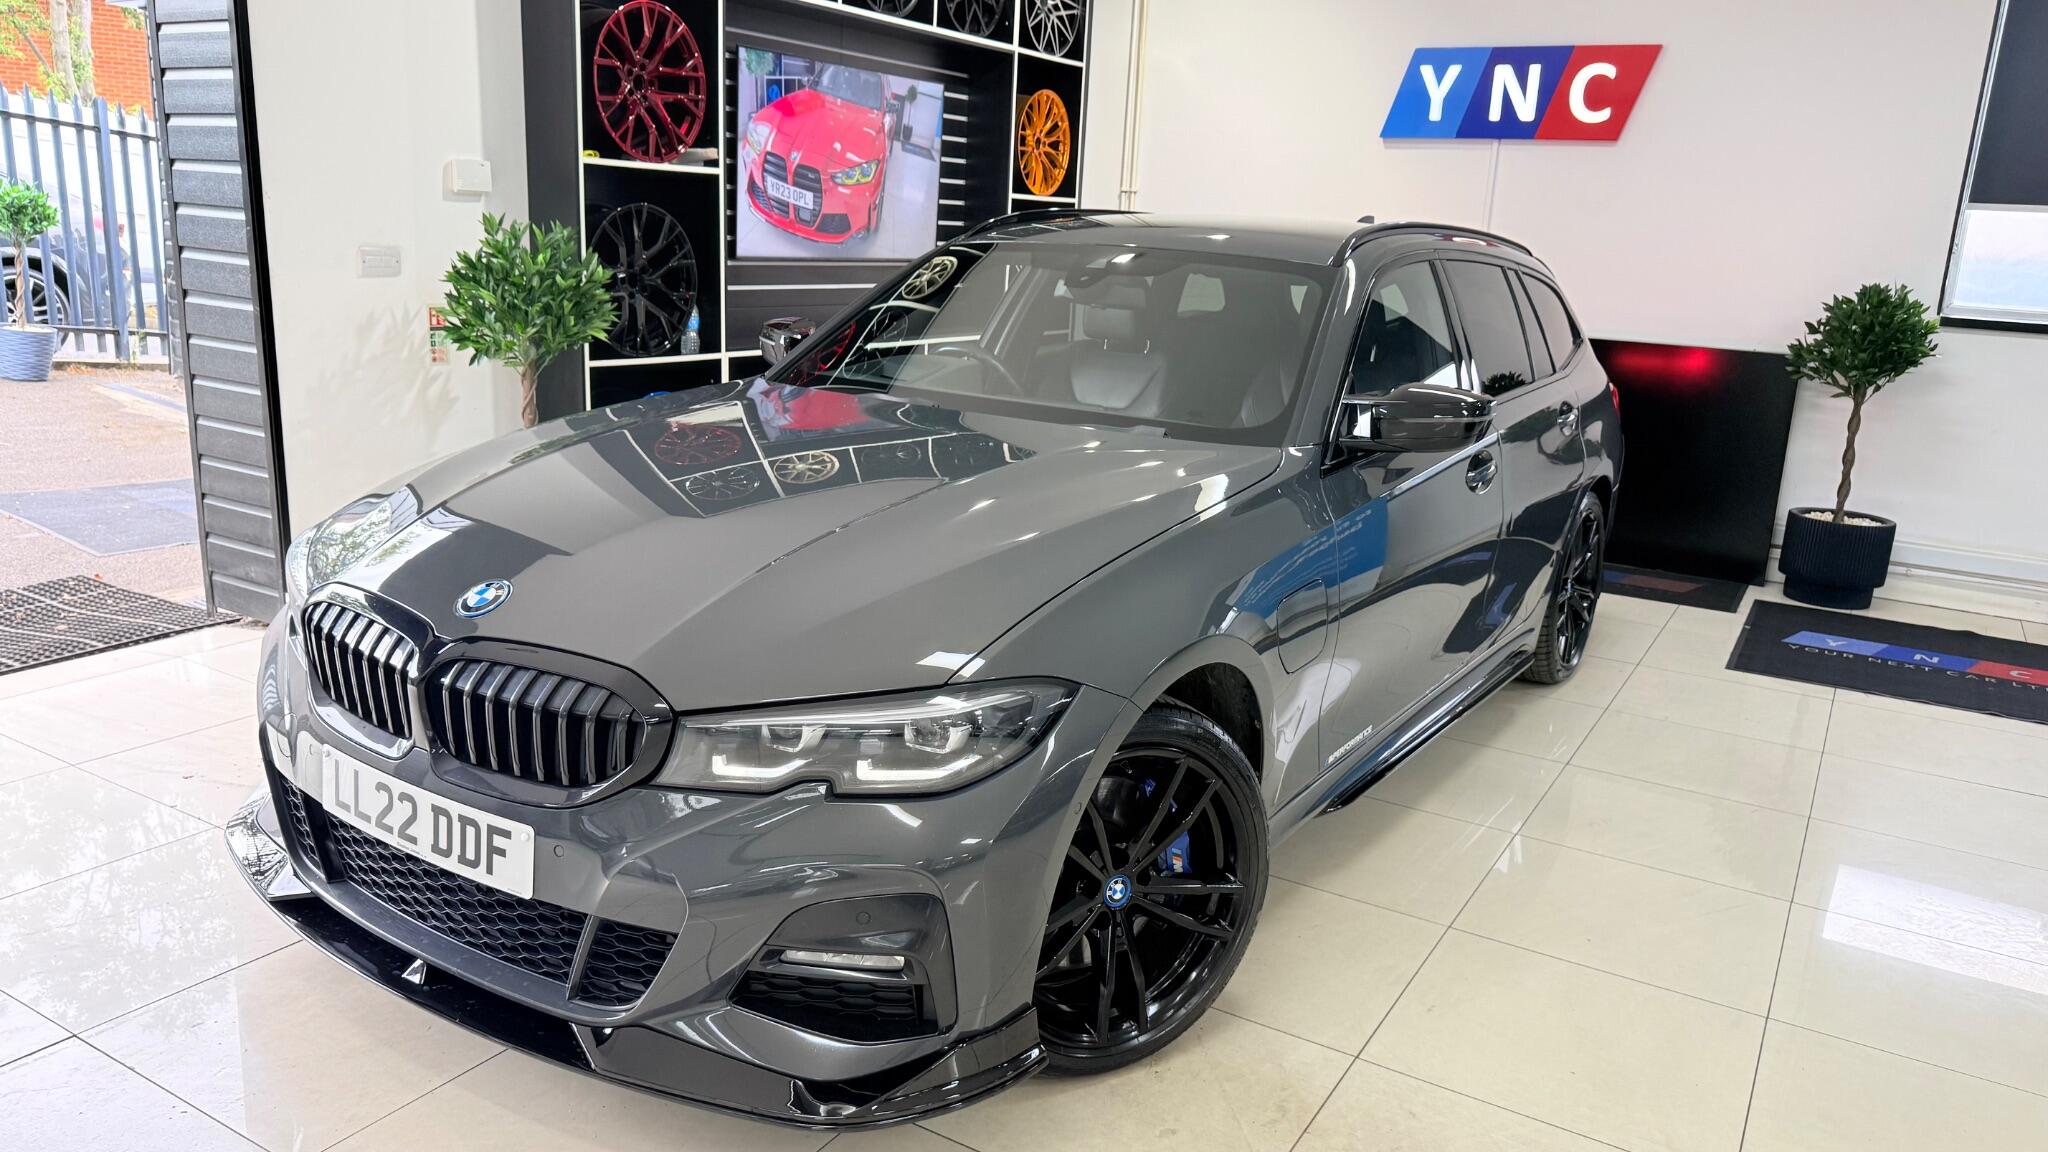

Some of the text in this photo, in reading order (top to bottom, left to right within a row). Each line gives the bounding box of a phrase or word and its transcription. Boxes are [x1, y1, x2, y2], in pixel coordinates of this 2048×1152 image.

[1420, 62, 1617, 124] YNC
[1788, 643, 2048, 692] YOUR NEXT CAR LT
[334, 758, 513, 876] LL22 DDF
